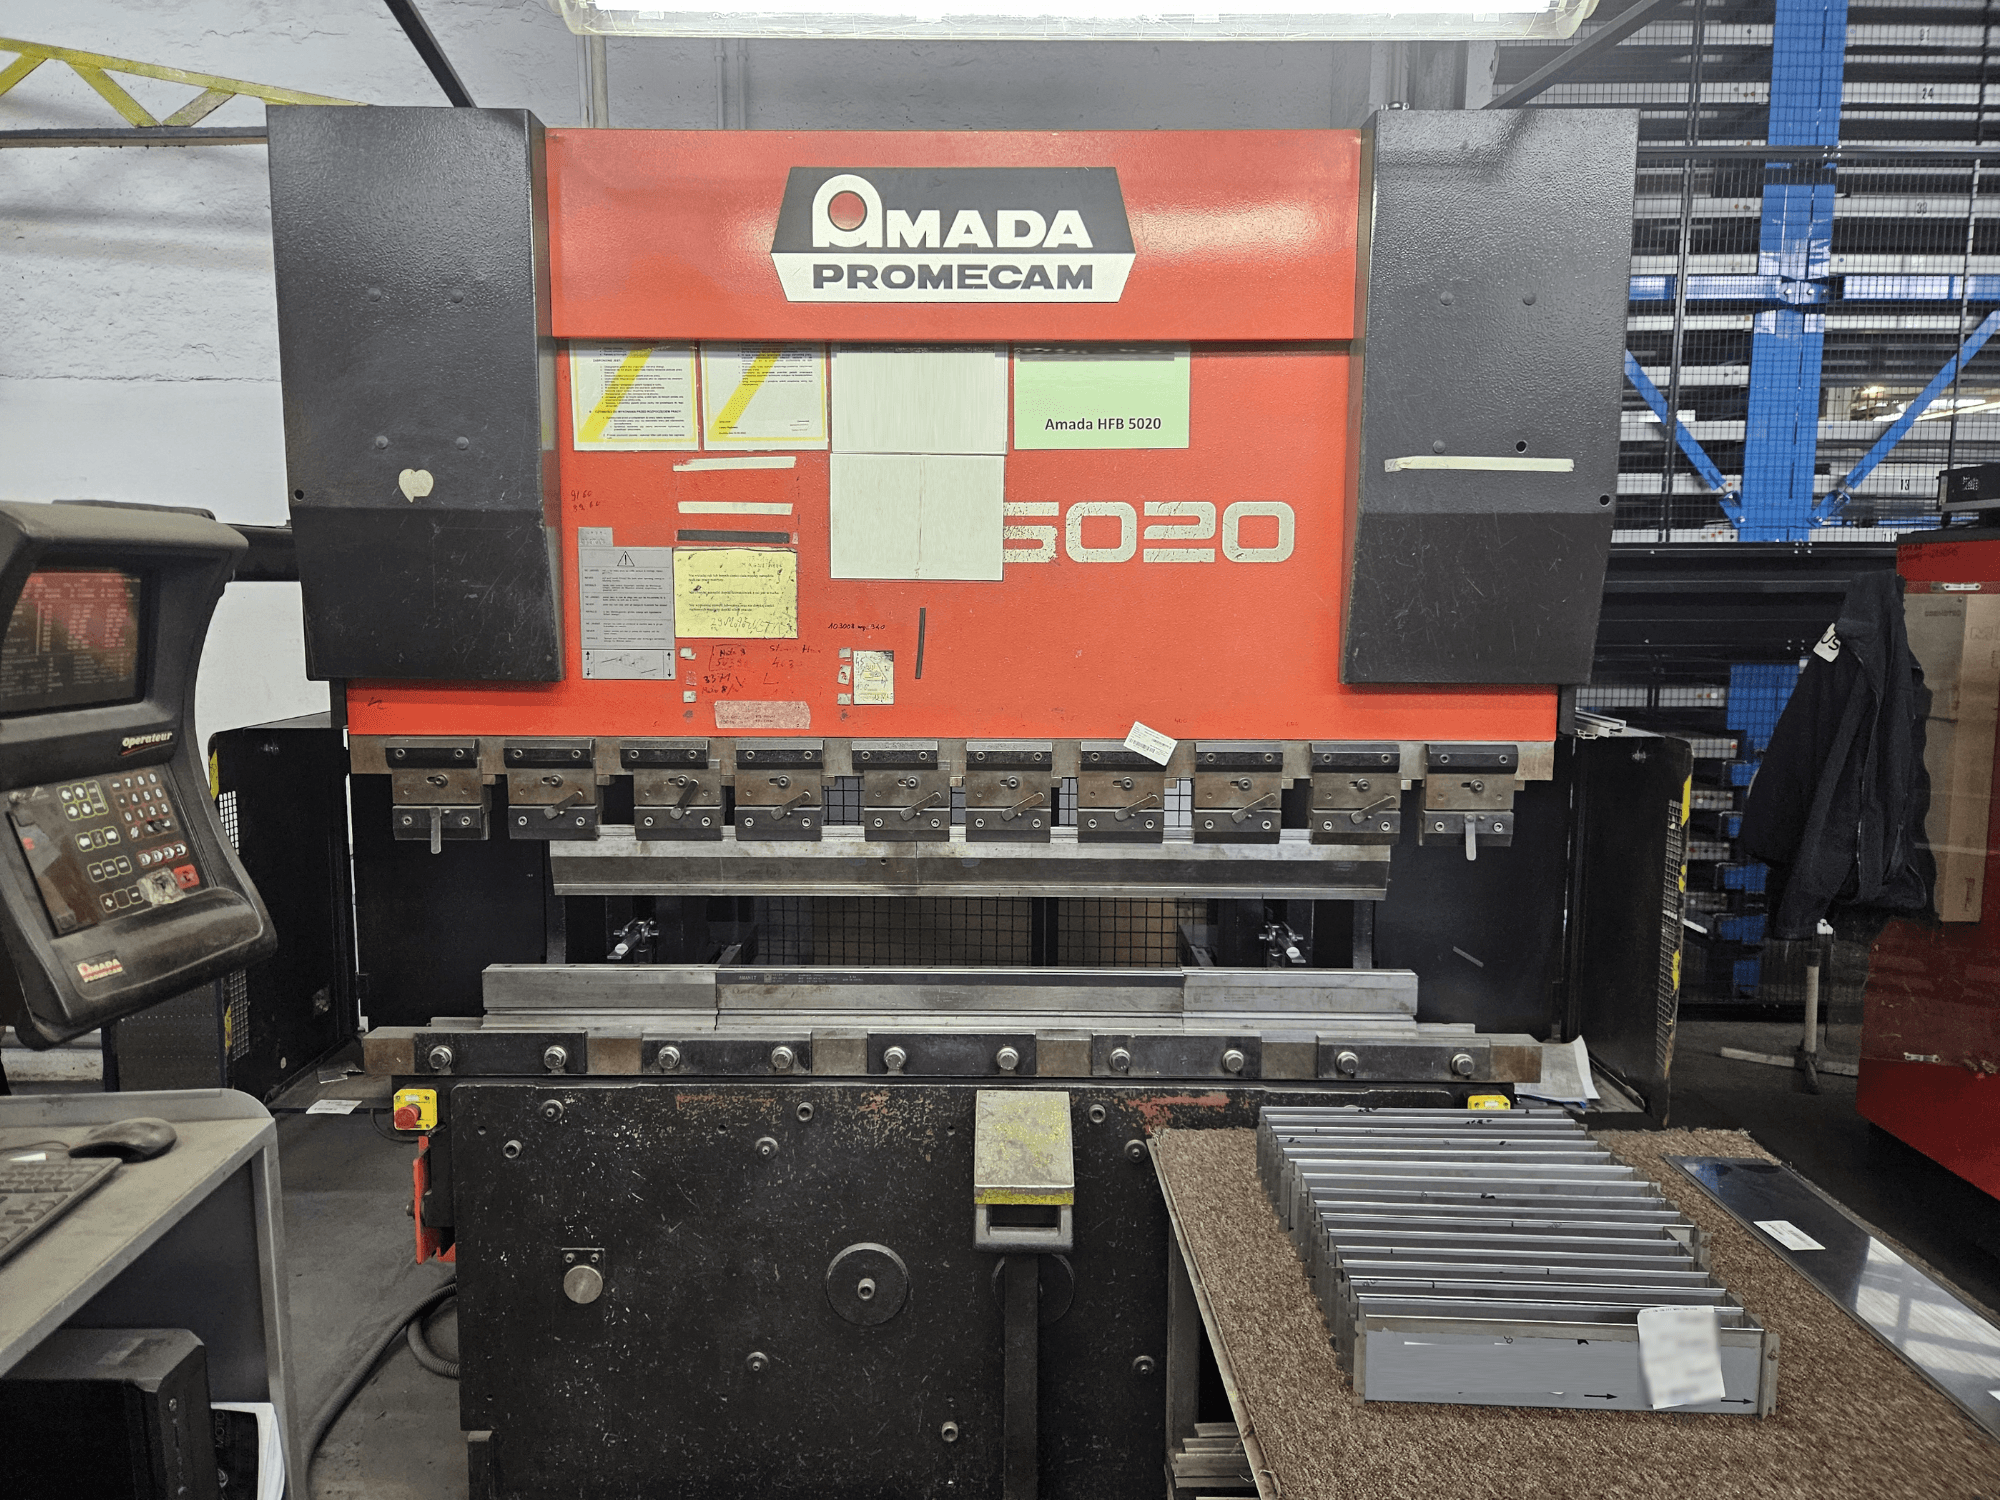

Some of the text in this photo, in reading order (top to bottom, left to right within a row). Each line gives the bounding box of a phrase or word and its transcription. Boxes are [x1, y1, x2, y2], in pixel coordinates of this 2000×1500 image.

[812, 173, 1093, 249] AMADA
[812, 263, 1093, 290] PROMECAM
[1045, 417, 1162, 430] Amada HFB 5020
[1900, 479, 1910, 491] 13
[122, 731, 173, 749] Operateur
[124, 773, 157, 788] 7 8 9
[131, 788, 163, 803] 4 5 6
[124, 803, 169, 822] 0 1 2 3
